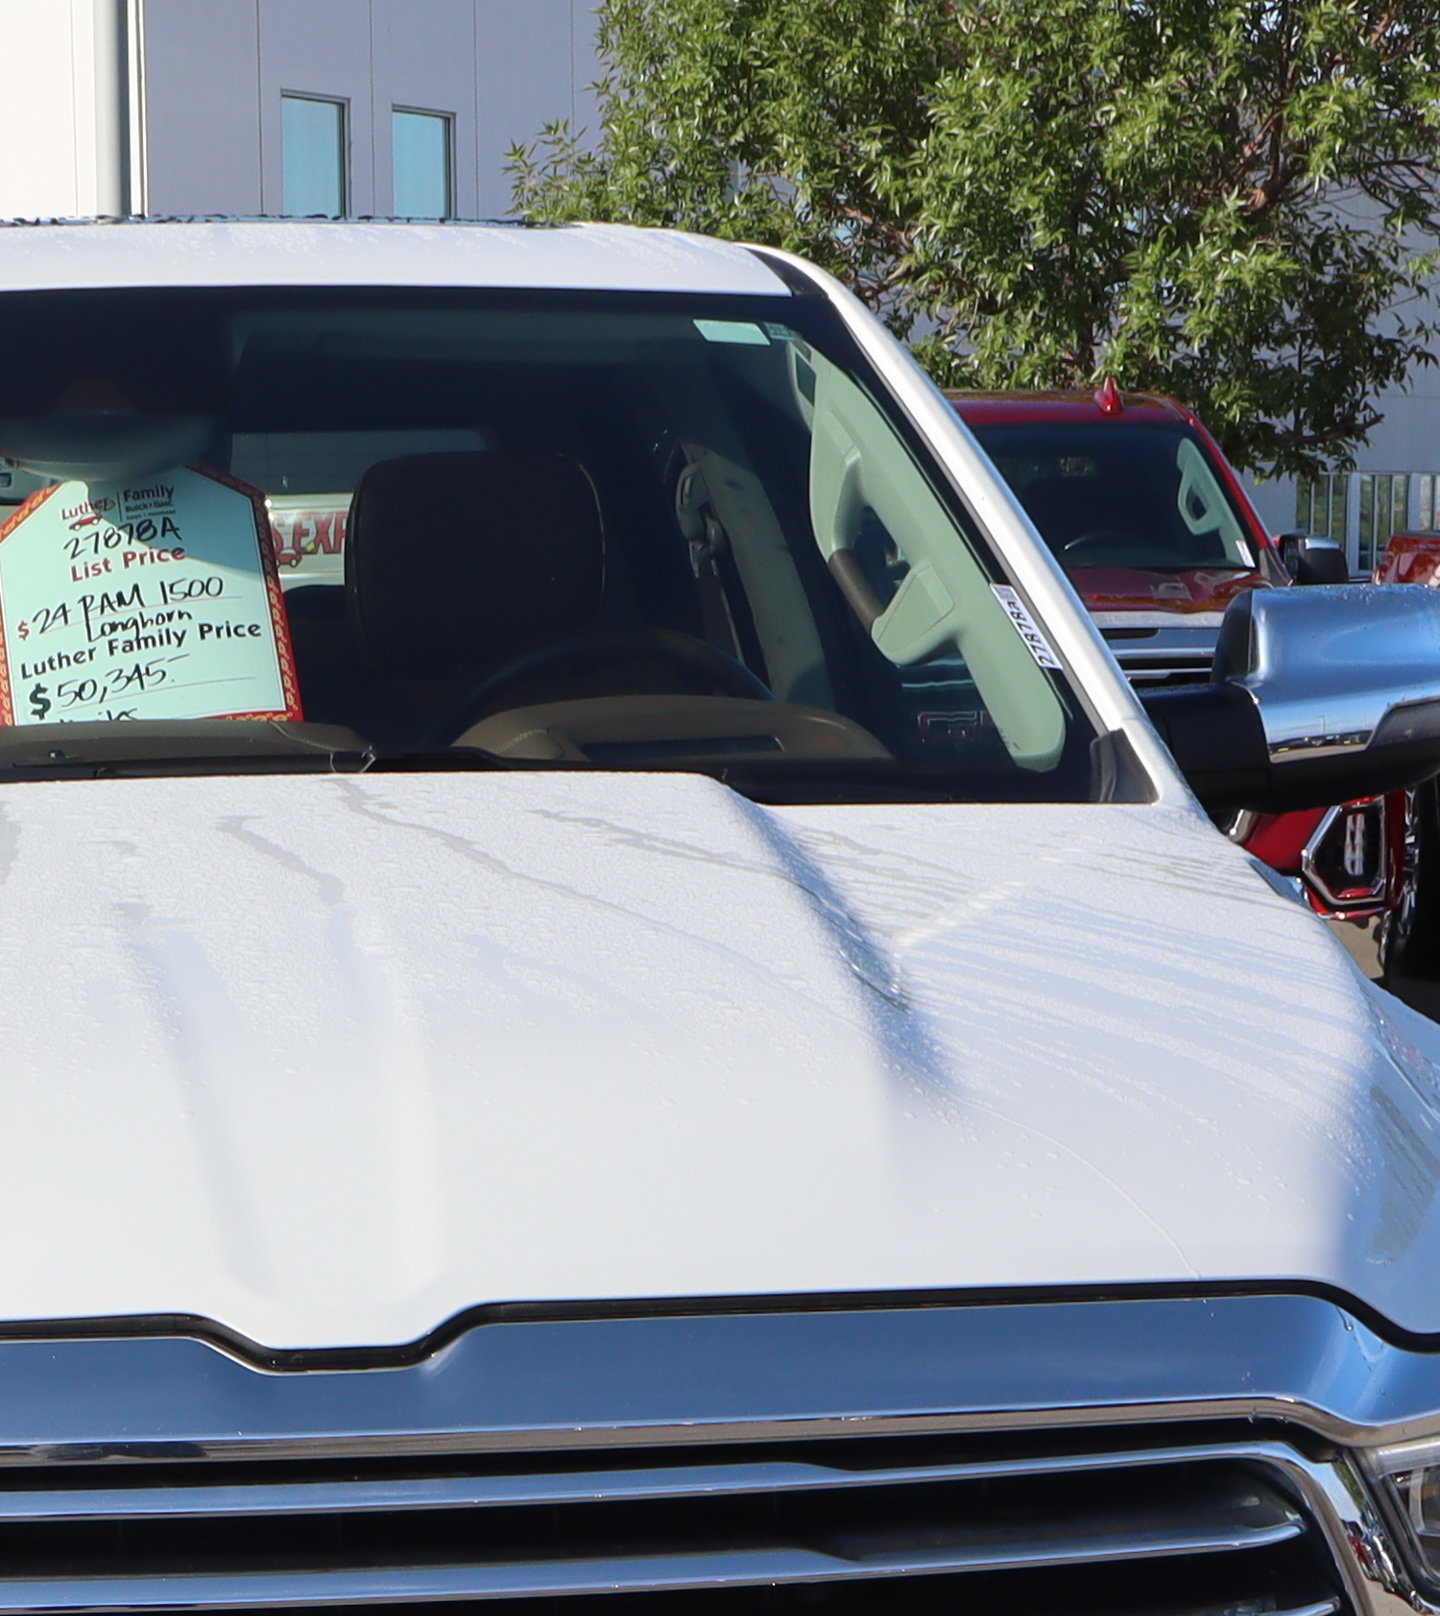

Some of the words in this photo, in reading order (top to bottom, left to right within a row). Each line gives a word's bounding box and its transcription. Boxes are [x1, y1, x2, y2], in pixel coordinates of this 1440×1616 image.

[62, 498, 108, 520] Luther
[124, 484, 174, 503] Family
[64, 517, 182, 560] 27878A
[71, 557, 112, 582] List
[123, 547, 186, 569] Price
[160, 577, 223, 604] 1500
[84, 608, 193, 643] Longhorn
[21, 647, 97, 680] Luther
[108, 629, 187, 657] Family
[199, 621, 262, 641] Price
